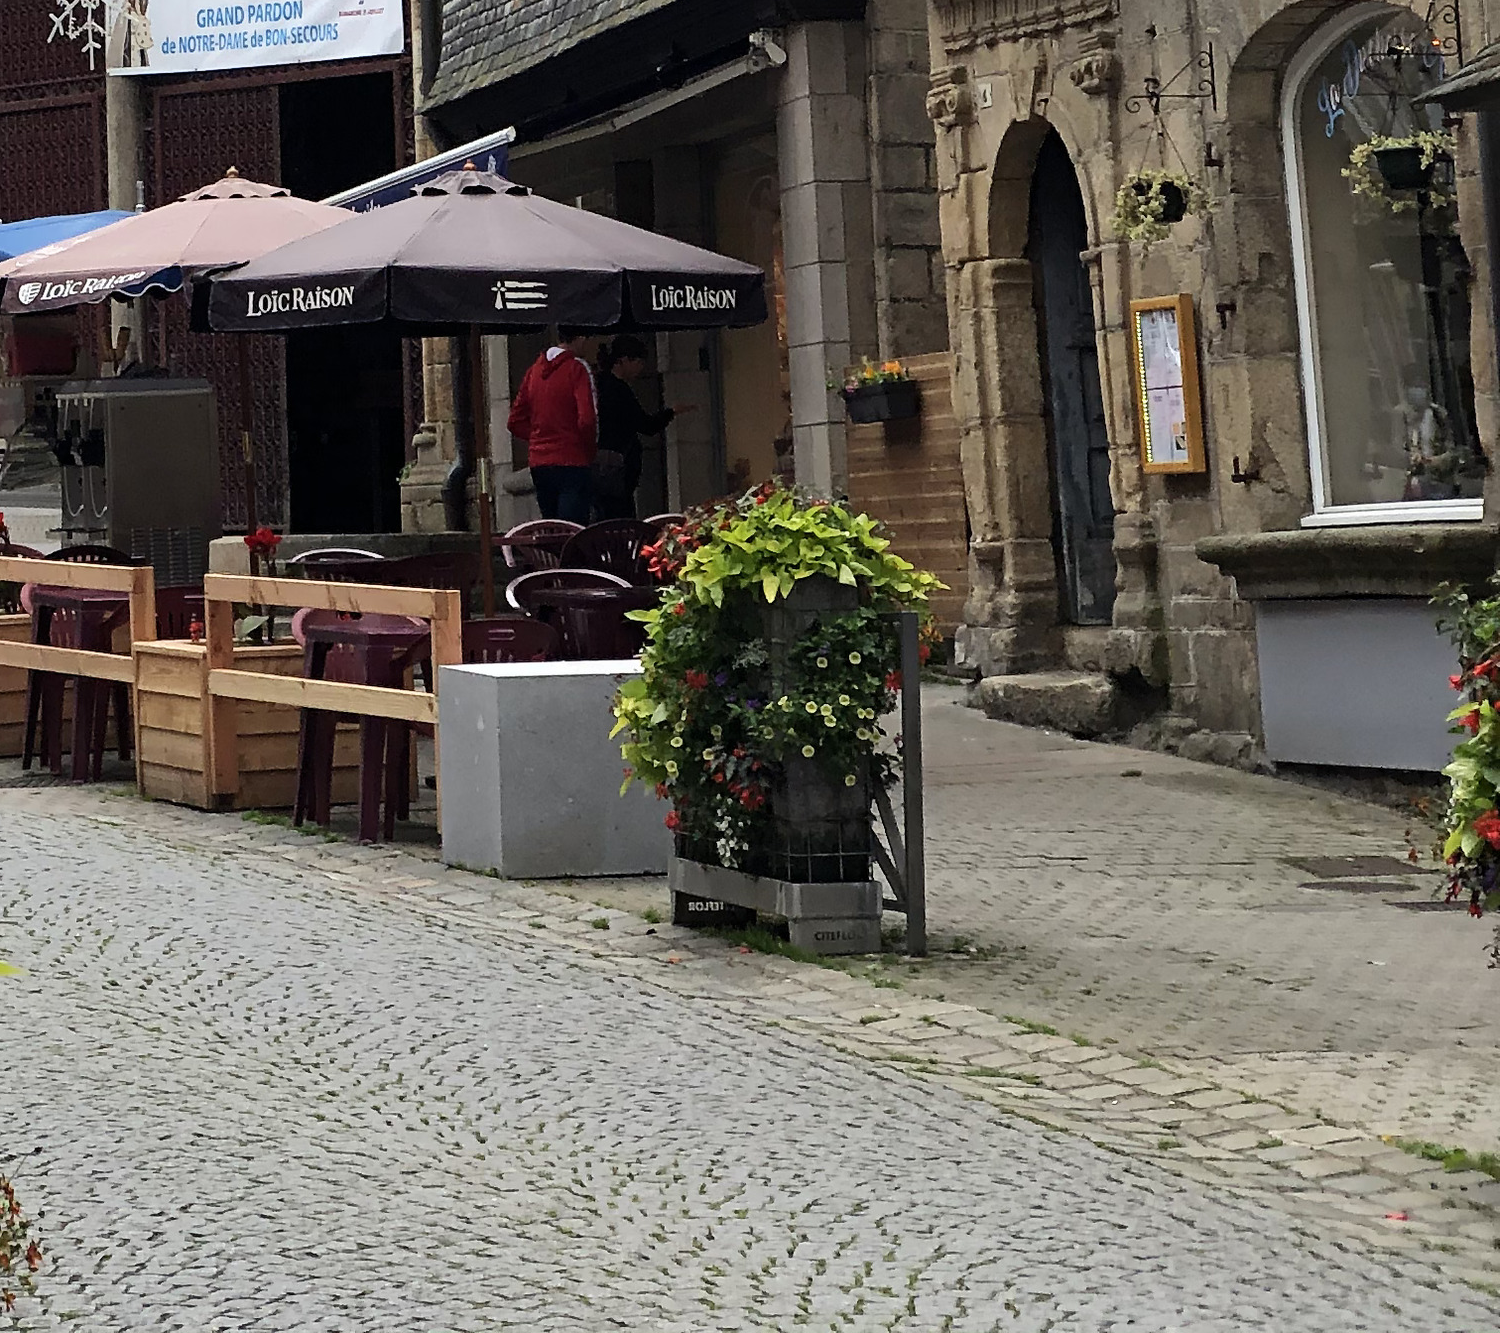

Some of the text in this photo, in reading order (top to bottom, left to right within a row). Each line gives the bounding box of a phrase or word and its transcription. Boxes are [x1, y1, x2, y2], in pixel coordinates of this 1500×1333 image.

[196, 0, 304, 28] GRAND PARDON
[161, 23, 339, 55] de NOTRE-DAME de BON-SECOURS
